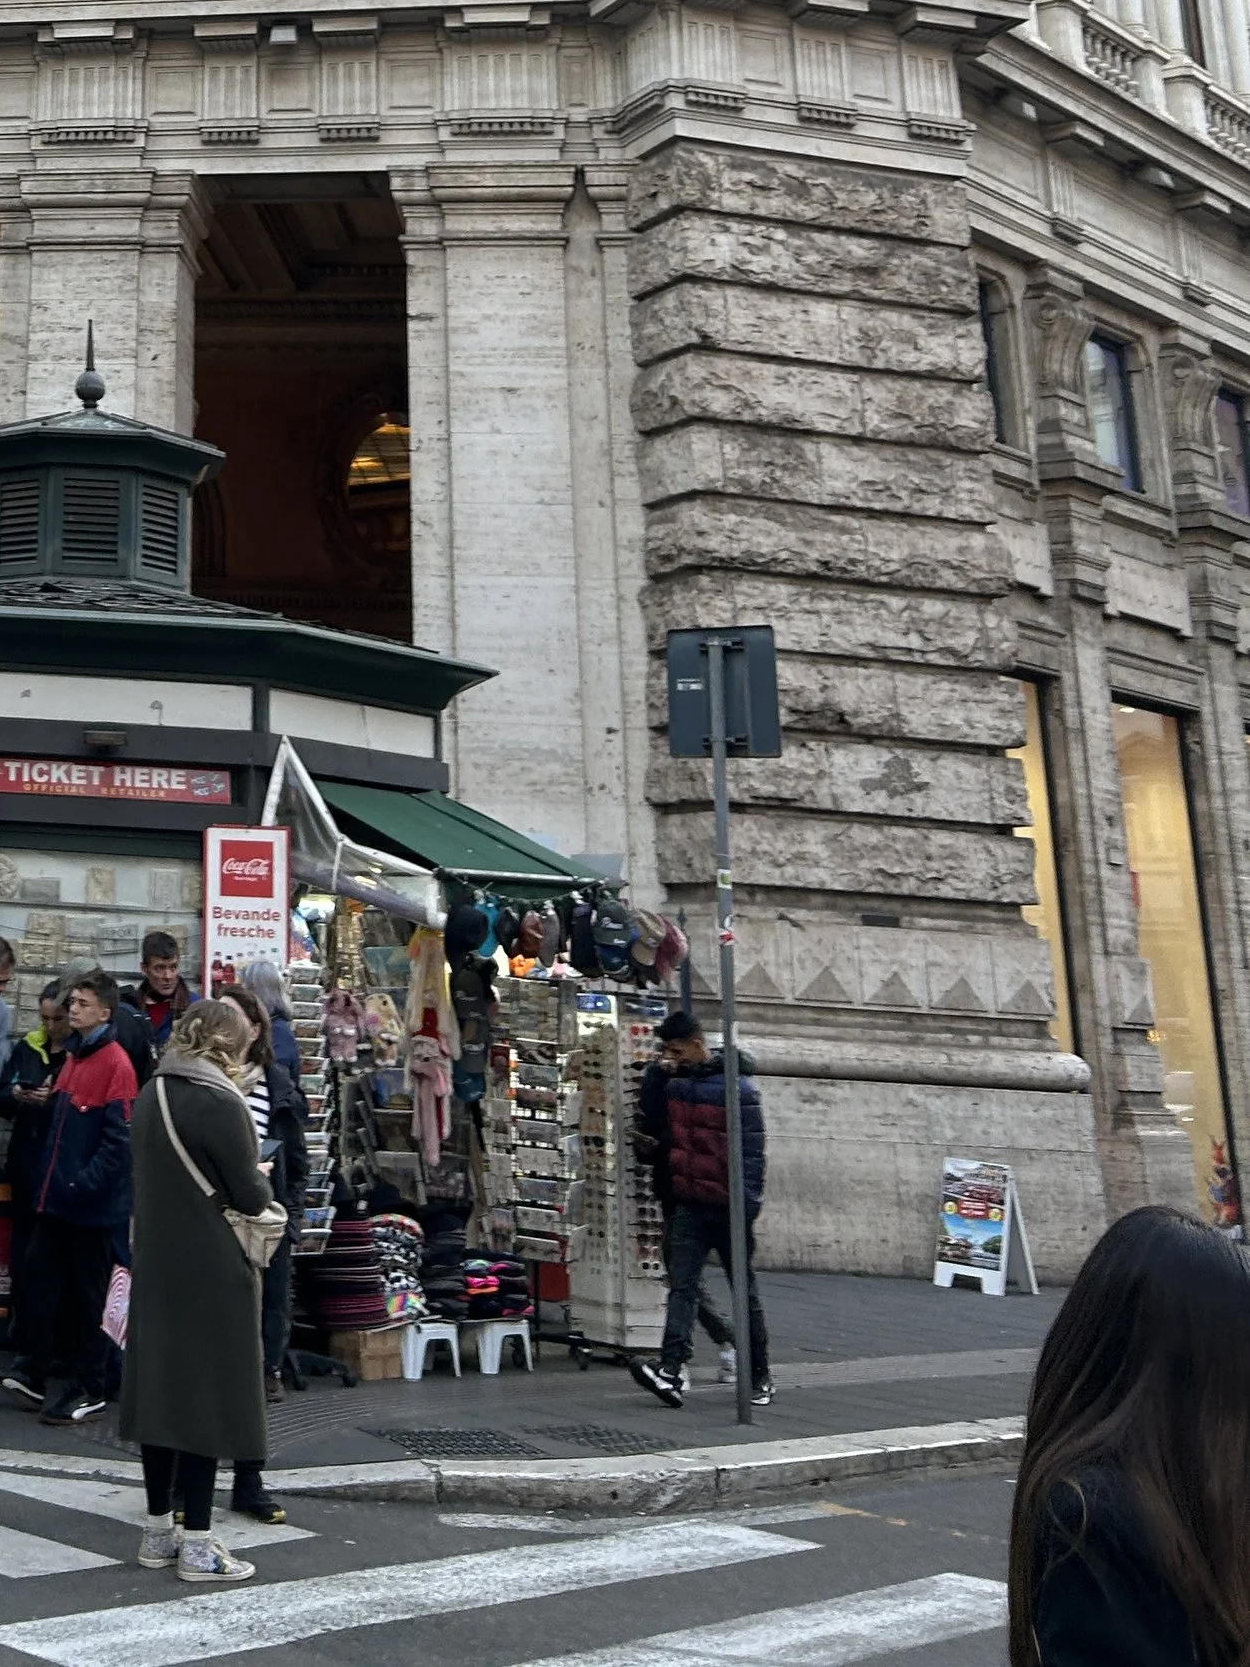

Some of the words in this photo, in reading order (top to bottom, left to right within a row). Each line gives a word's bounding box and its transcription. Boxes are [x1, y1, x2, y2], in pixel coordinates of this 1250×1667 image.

[3, 761, 105, 785] TICKET
[112, 765, 187, 790] HERE
[22, 783, 87, 794] OFFICIAL
[101, 787, 167, 798] RETAILER
[222, 857, 271, 875] Coca-Cola
[212, 906, 281, 922] Bevande
[217, 924, 276, 939] fresche
